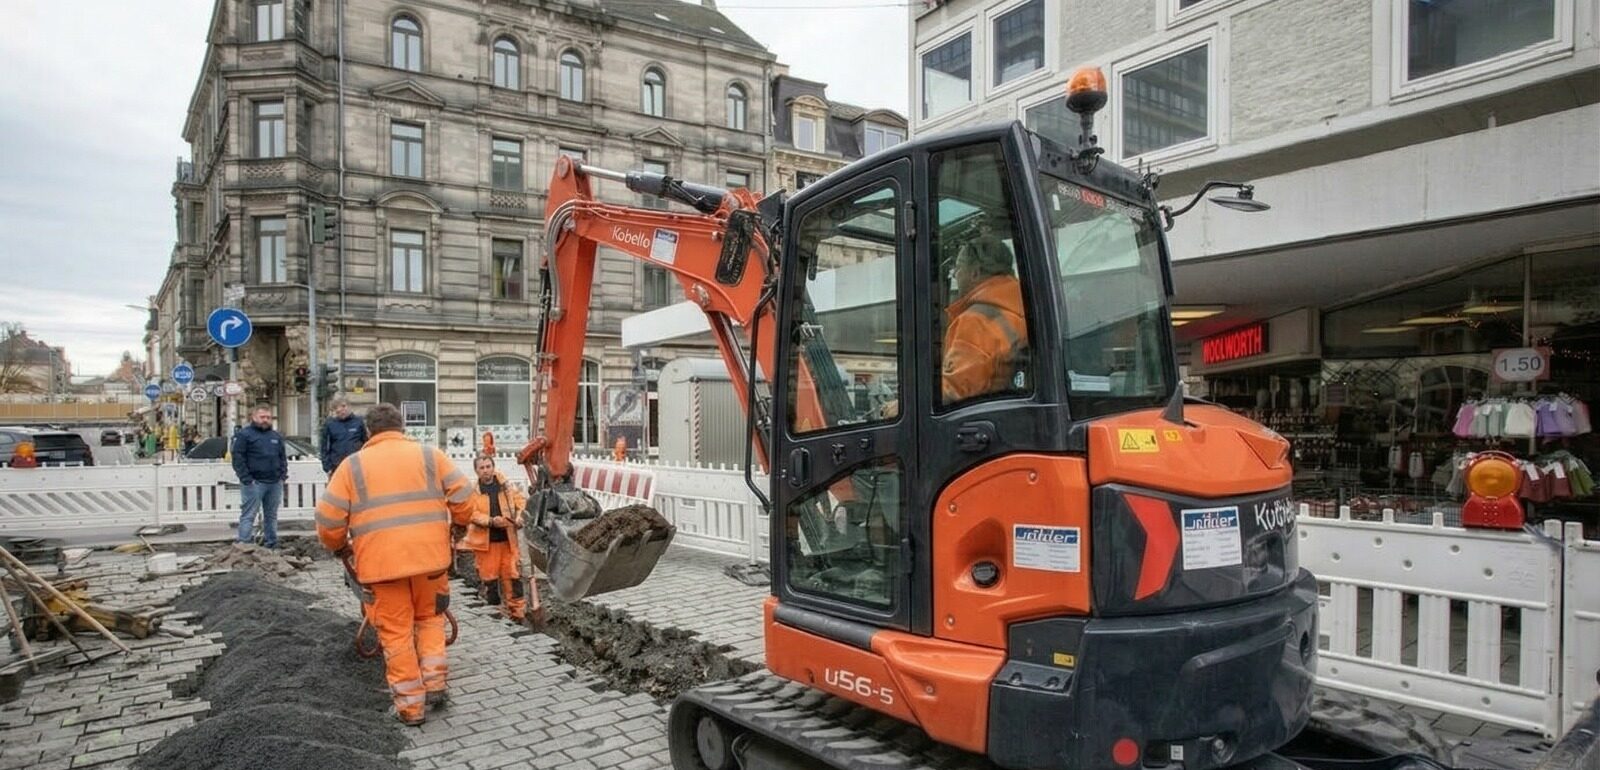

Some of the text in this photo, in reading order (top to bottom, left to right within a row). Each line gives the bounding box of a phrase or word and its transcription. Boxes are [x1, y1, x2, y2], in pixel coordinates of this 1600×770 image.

[612, 225, 651, 248] Kobello
[1203, 325, 1262, 363] WOOLWORTH
[1500, 356, 1541, 371] 1.50
